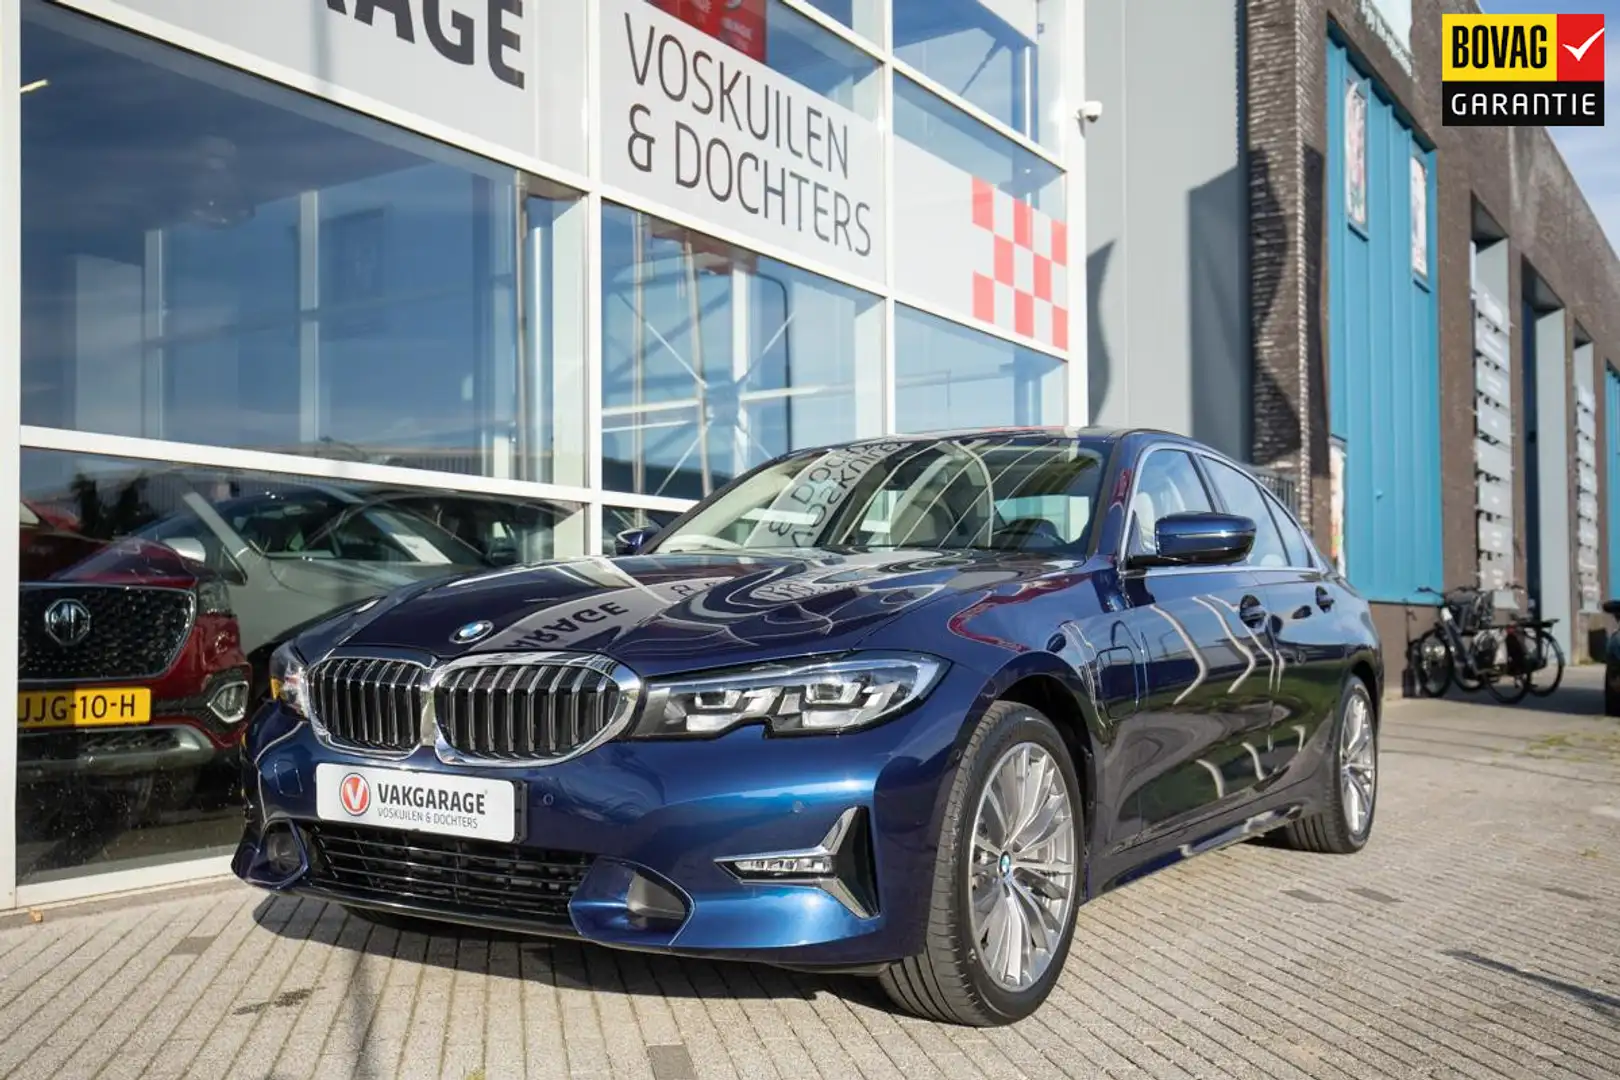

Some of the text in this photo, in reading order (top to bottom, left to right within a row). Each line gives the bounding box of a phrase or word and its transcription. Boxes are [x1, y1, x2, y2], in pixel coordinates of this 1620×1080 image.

[326, 0, 525, 90] AGE
[624, 12, 849, 180] VOSKUILEN
[627, 103, 871, 257] & DOCHTERS
[377, 783, 486, 815] VAKGARAGE
[377, 807, 478, 829] VOSKUILEN & DOCHTERS
